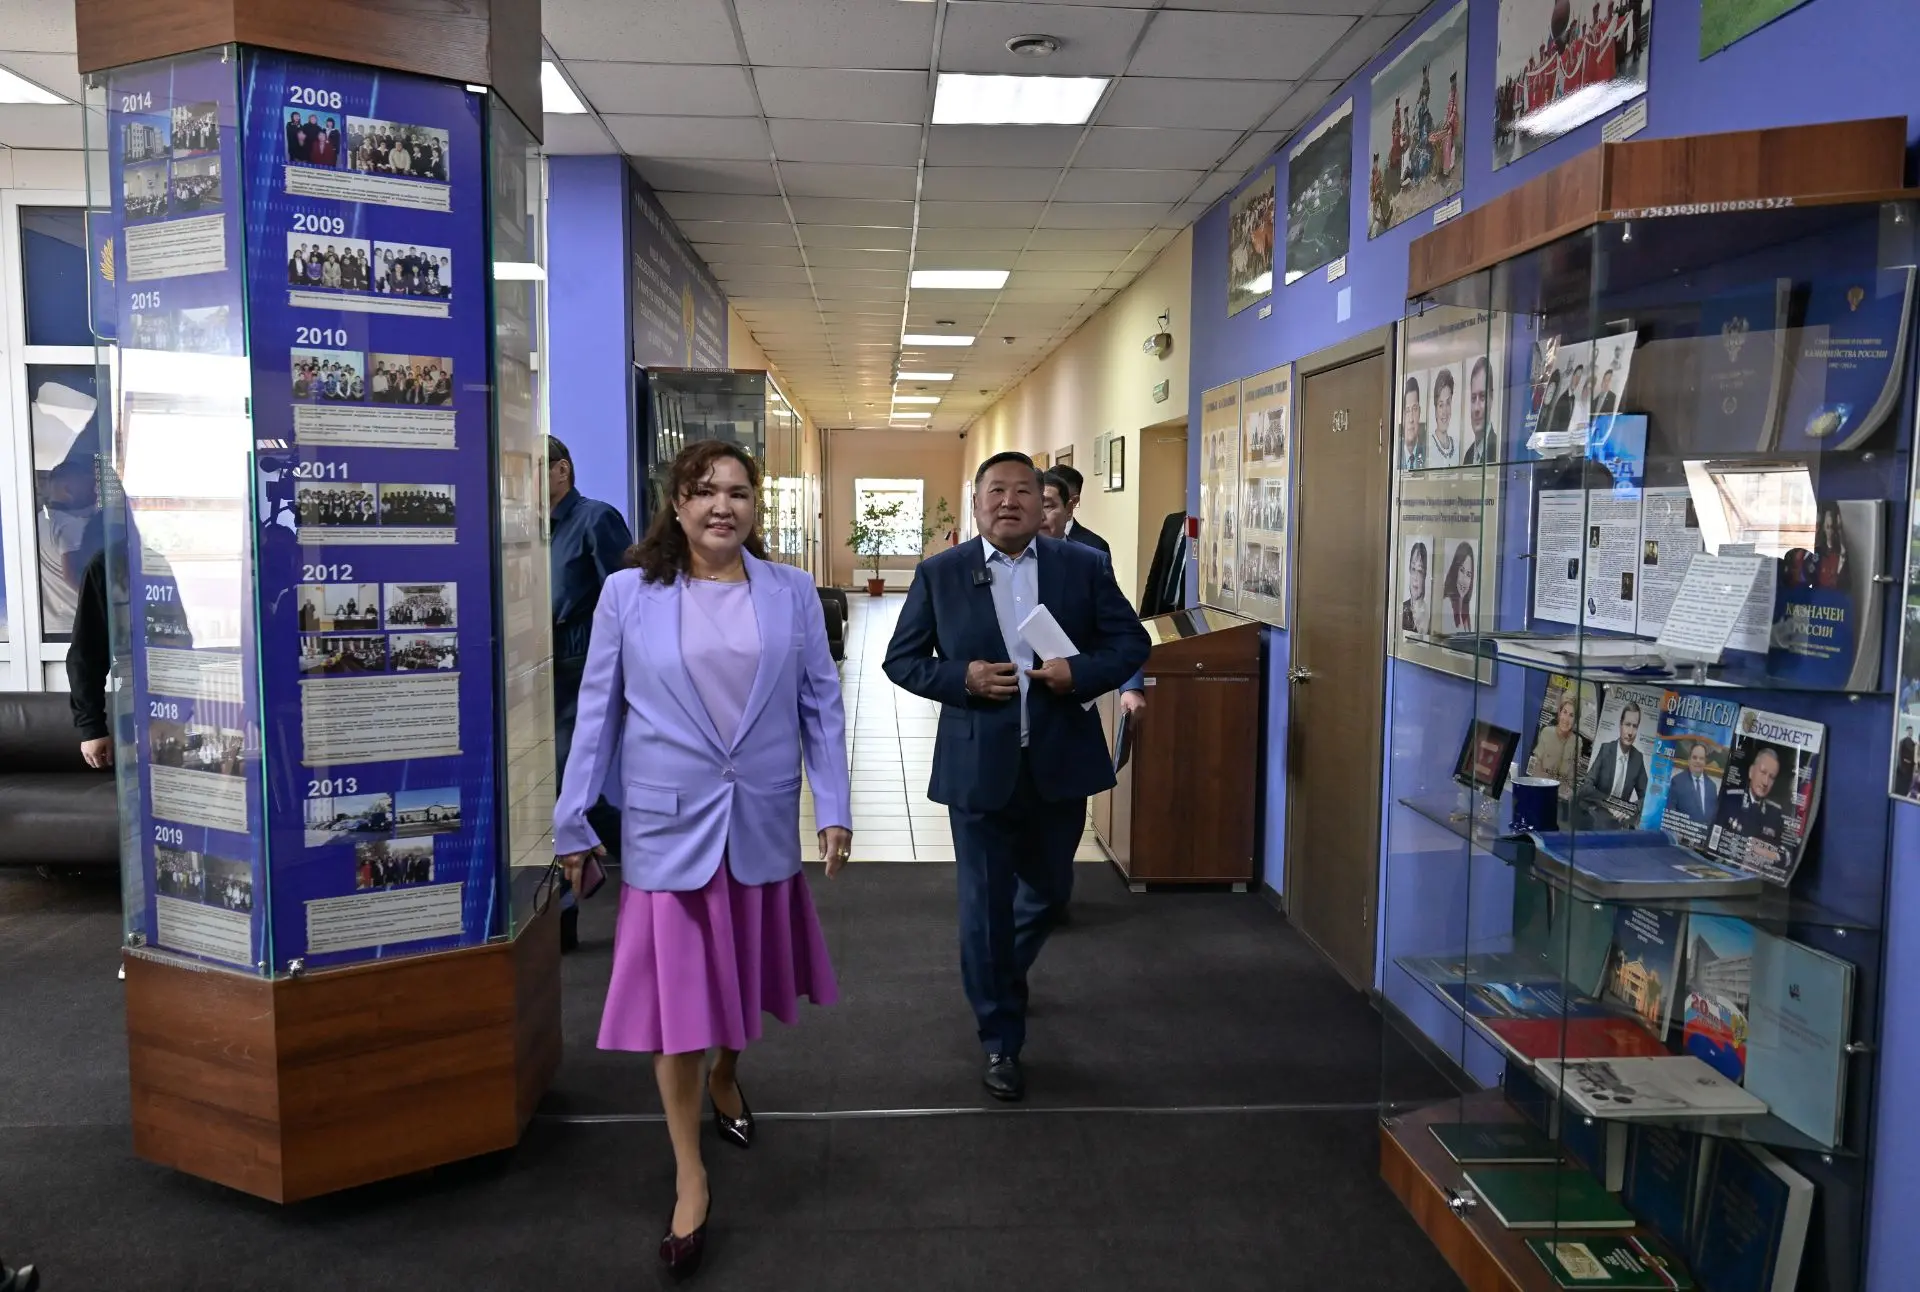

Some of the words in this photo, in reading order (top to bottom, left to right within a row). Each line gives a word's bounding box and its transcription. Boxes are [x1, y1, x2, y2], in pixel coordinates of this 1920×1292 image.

[122, 91, 152, 113] 2014
[289, 85, 342, 110] 2008
[292, 213, 345, 235] 2009
[131, 291, 160, 311] 2015
[296, 327, 348, 347] 2010
[299, 461, 349, 480] 2011
[302, 564, 353, 582] 2012
[145, 584, 173, 602] 2017
[1793, 621, 1833, 639] РОССИИ
[1615, 686, 1661, 710] БЮДЖЕТ
[150, 701, 178, 720] 2018
[1667, 695, 1735, 728] ФИНАНСЫ
[1750, 718, 1813, 747] БЮДЖЕТ
[307, 777, 358, 797] 2013
[154, 825, 183, 846] 2019
